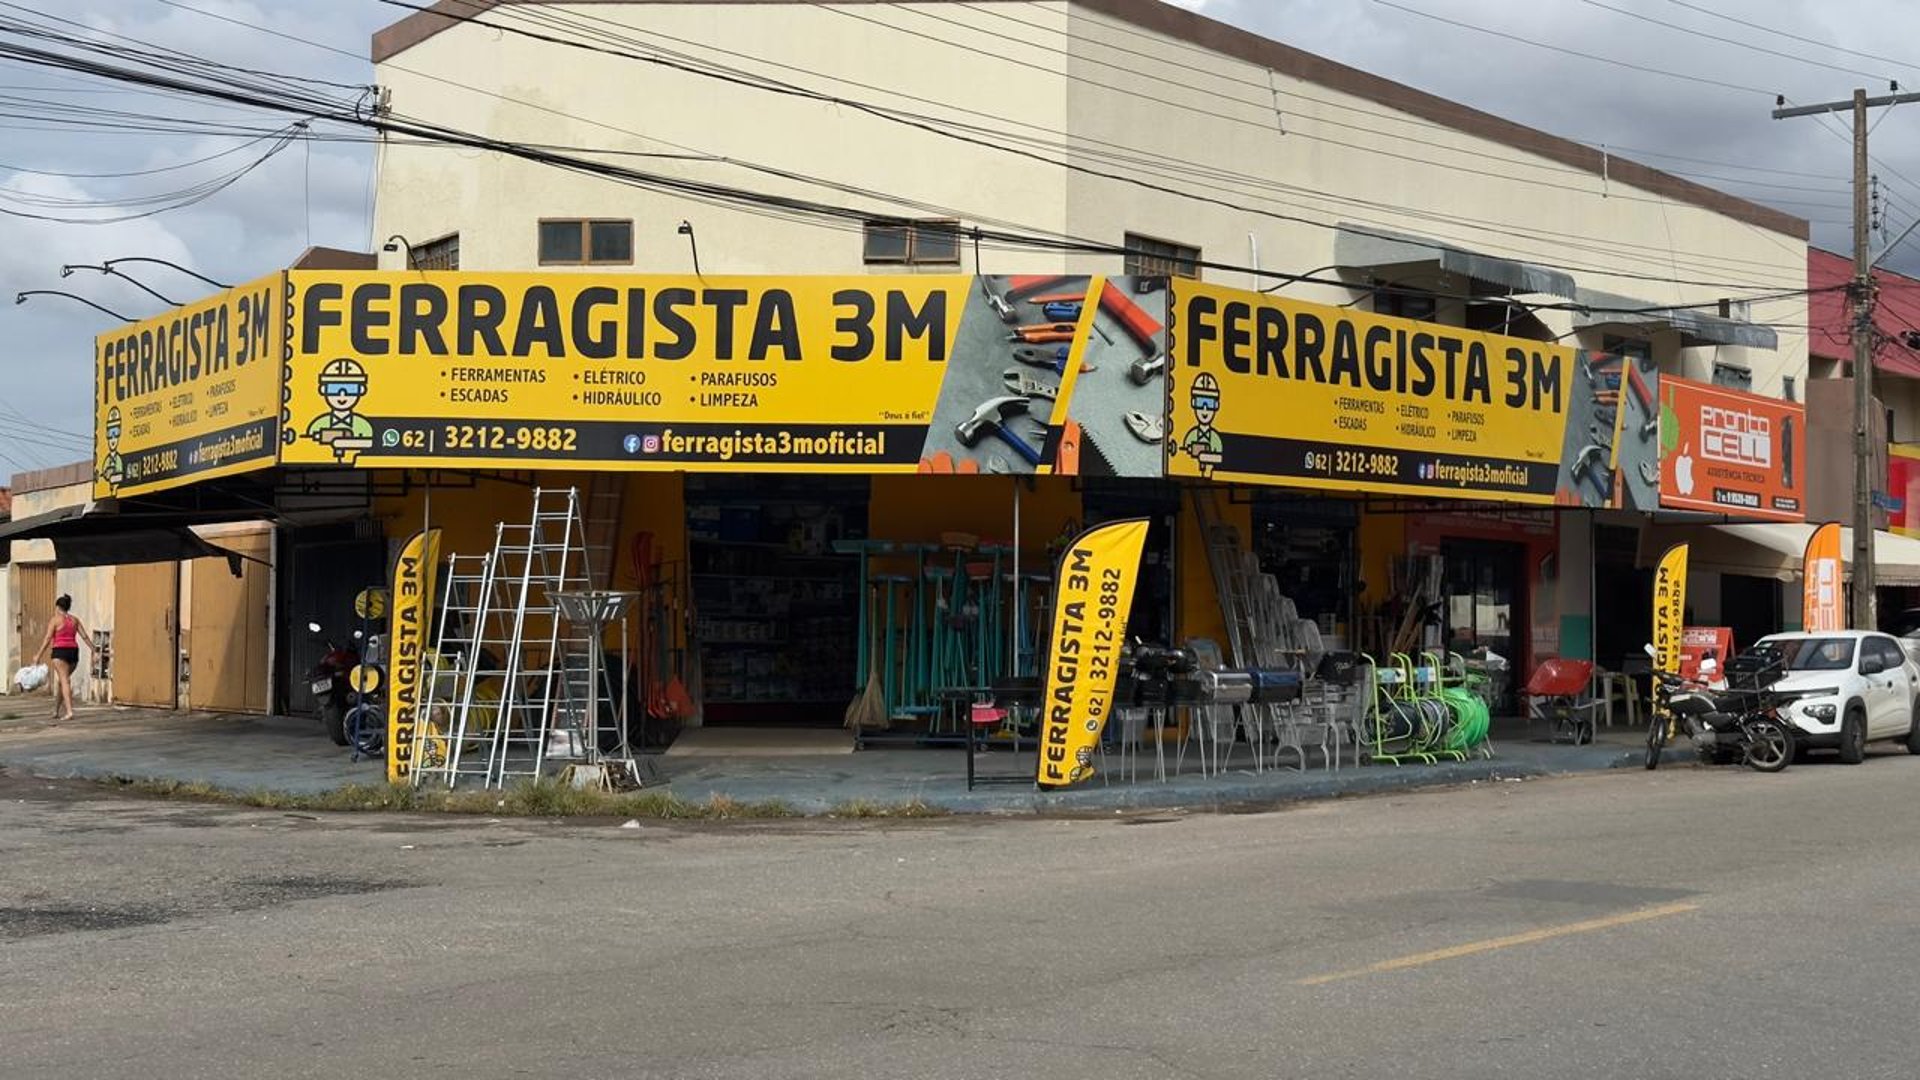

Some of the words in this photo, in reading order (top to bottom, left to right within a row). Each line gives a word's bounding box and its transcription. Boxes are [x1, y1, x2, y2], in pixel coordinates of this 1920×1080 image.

[301, 283, 803, 361] FERRAGISTA
[830, 288, 947, 362] 3M
[104, 303, 229, 404] FERRAGISTA
[236, 287, 271, 366] 3M
[1187, 295, 1491, 404] FERRAGISTA
[1505, 347, 1561, 413] 3M
[451, 368, 546, 383] FERRAMENTAS
[584, 367, 646, 385] ELÉTRICO
[701, 372, 777, 387] PARAFUSOS
[450, 388, 508, 402] ESCADAS
[583, 389, 662, 406] HIDRÁULICO
[700, 392, 758, 407] LIMPEZA
[1339, 397, 1384, 414] FERRAMENTAS
[402, 430, 425, 447] 62
[445, 425, 577, 450] 3212-9882
[662, 429, 885, 460] ferragista3moficial
[1336, 450, 1398, 476] 3212-9882
[1434, 458, 1528, 487] ferragista3moficial
[401, 557, 417, 596] 3M
[1658, 567, 1669, 598] 3M
[1090, 568, 1121, 680] 3212-9882
[1046, 601, 1086, 780] FERRAGISTA
[1068, 548, 1093, 592] 3M
[396, 611, 417, 778] FERRAGISTA
[1088, 696, 1104, 716] 62
